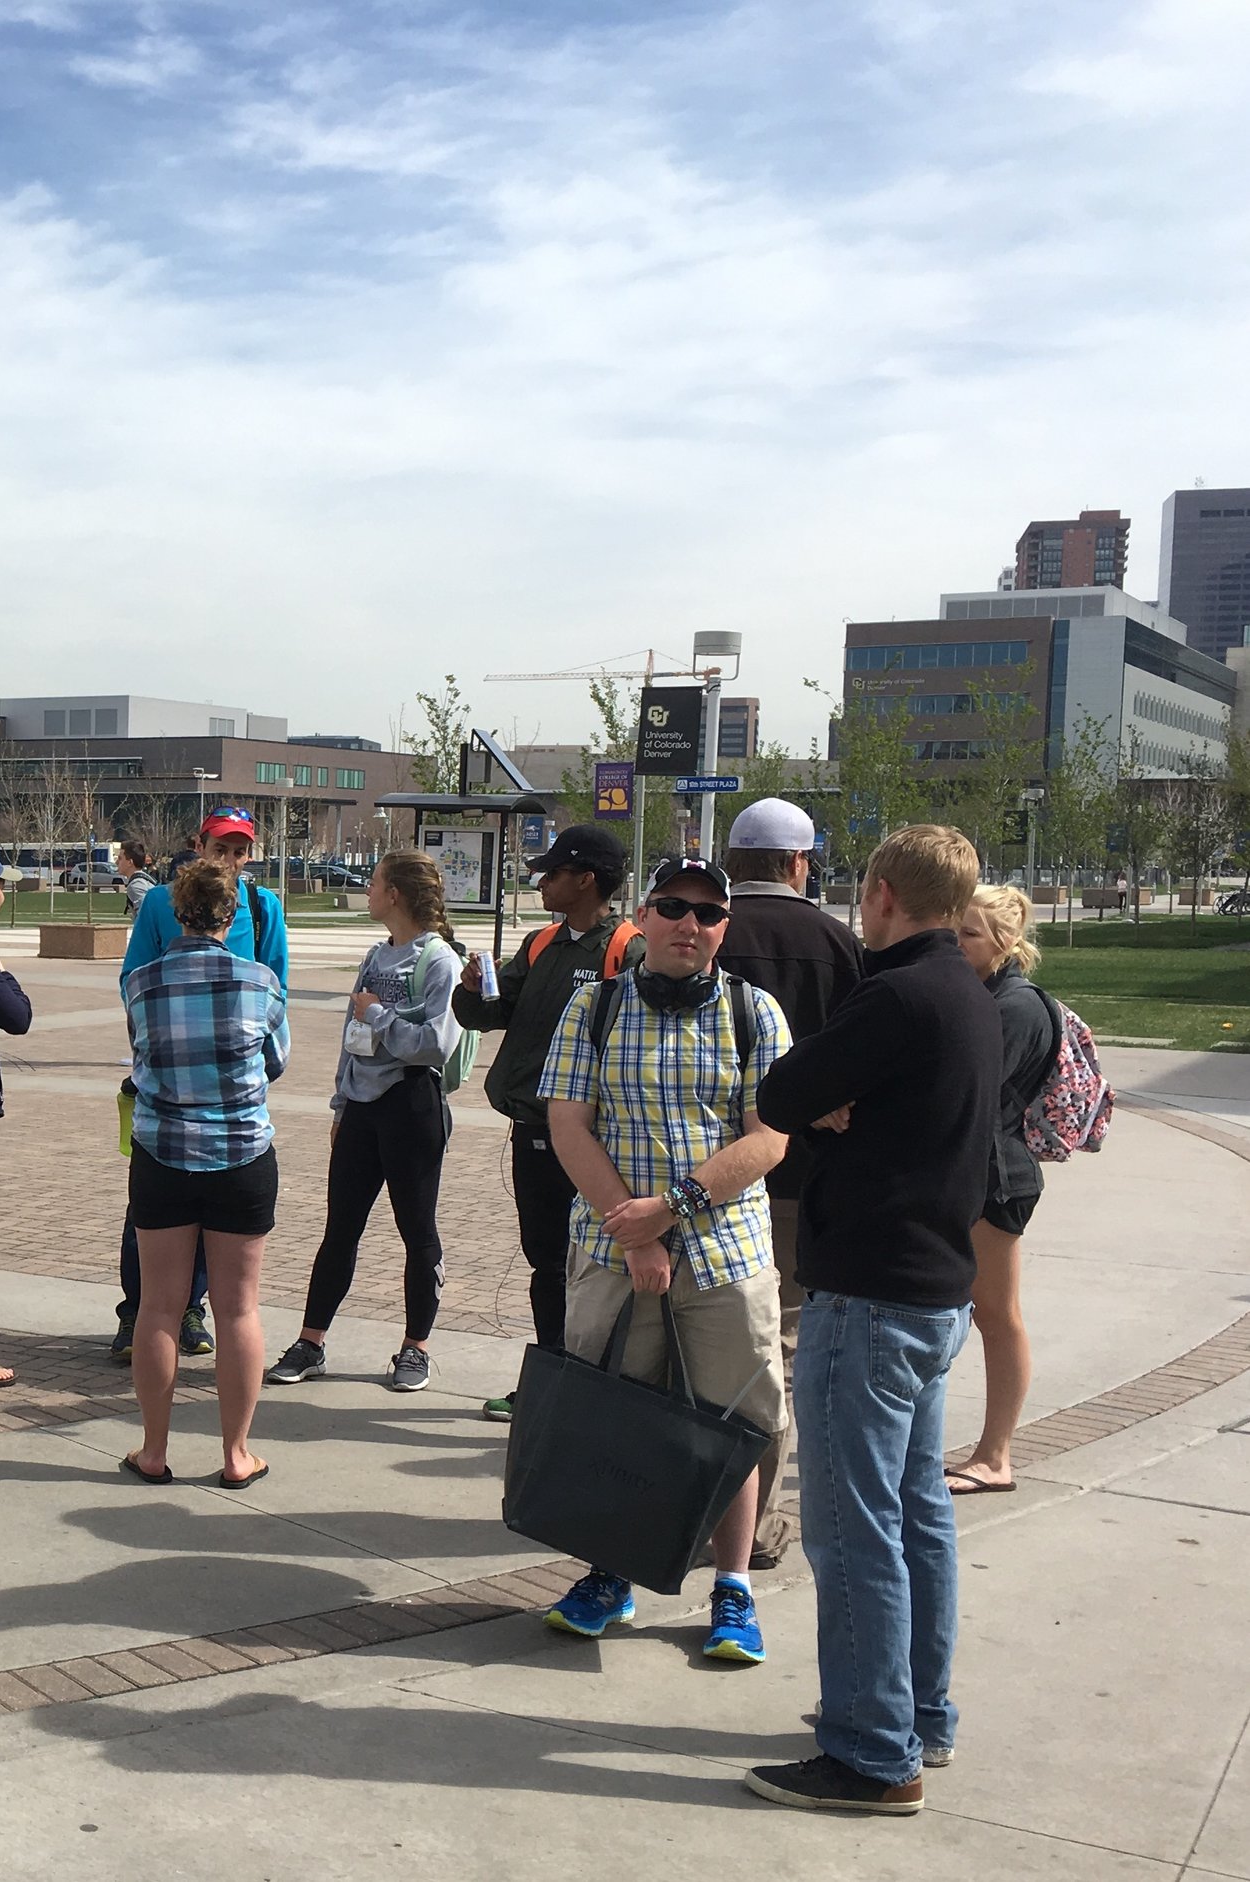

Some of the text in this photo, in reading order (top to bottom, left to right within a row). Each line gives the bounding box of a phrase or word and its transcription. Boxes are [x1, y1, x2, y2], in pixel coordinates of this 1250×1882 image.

[647, 705, 670, 727] CU
[645, 731, 684, 741] University
[644, 740, 692, 749] of Colorado
[643, 749, 672, 758] Denver
[598, 788, 628, 810] 50
[573, 969, 598, 980] MATIX
